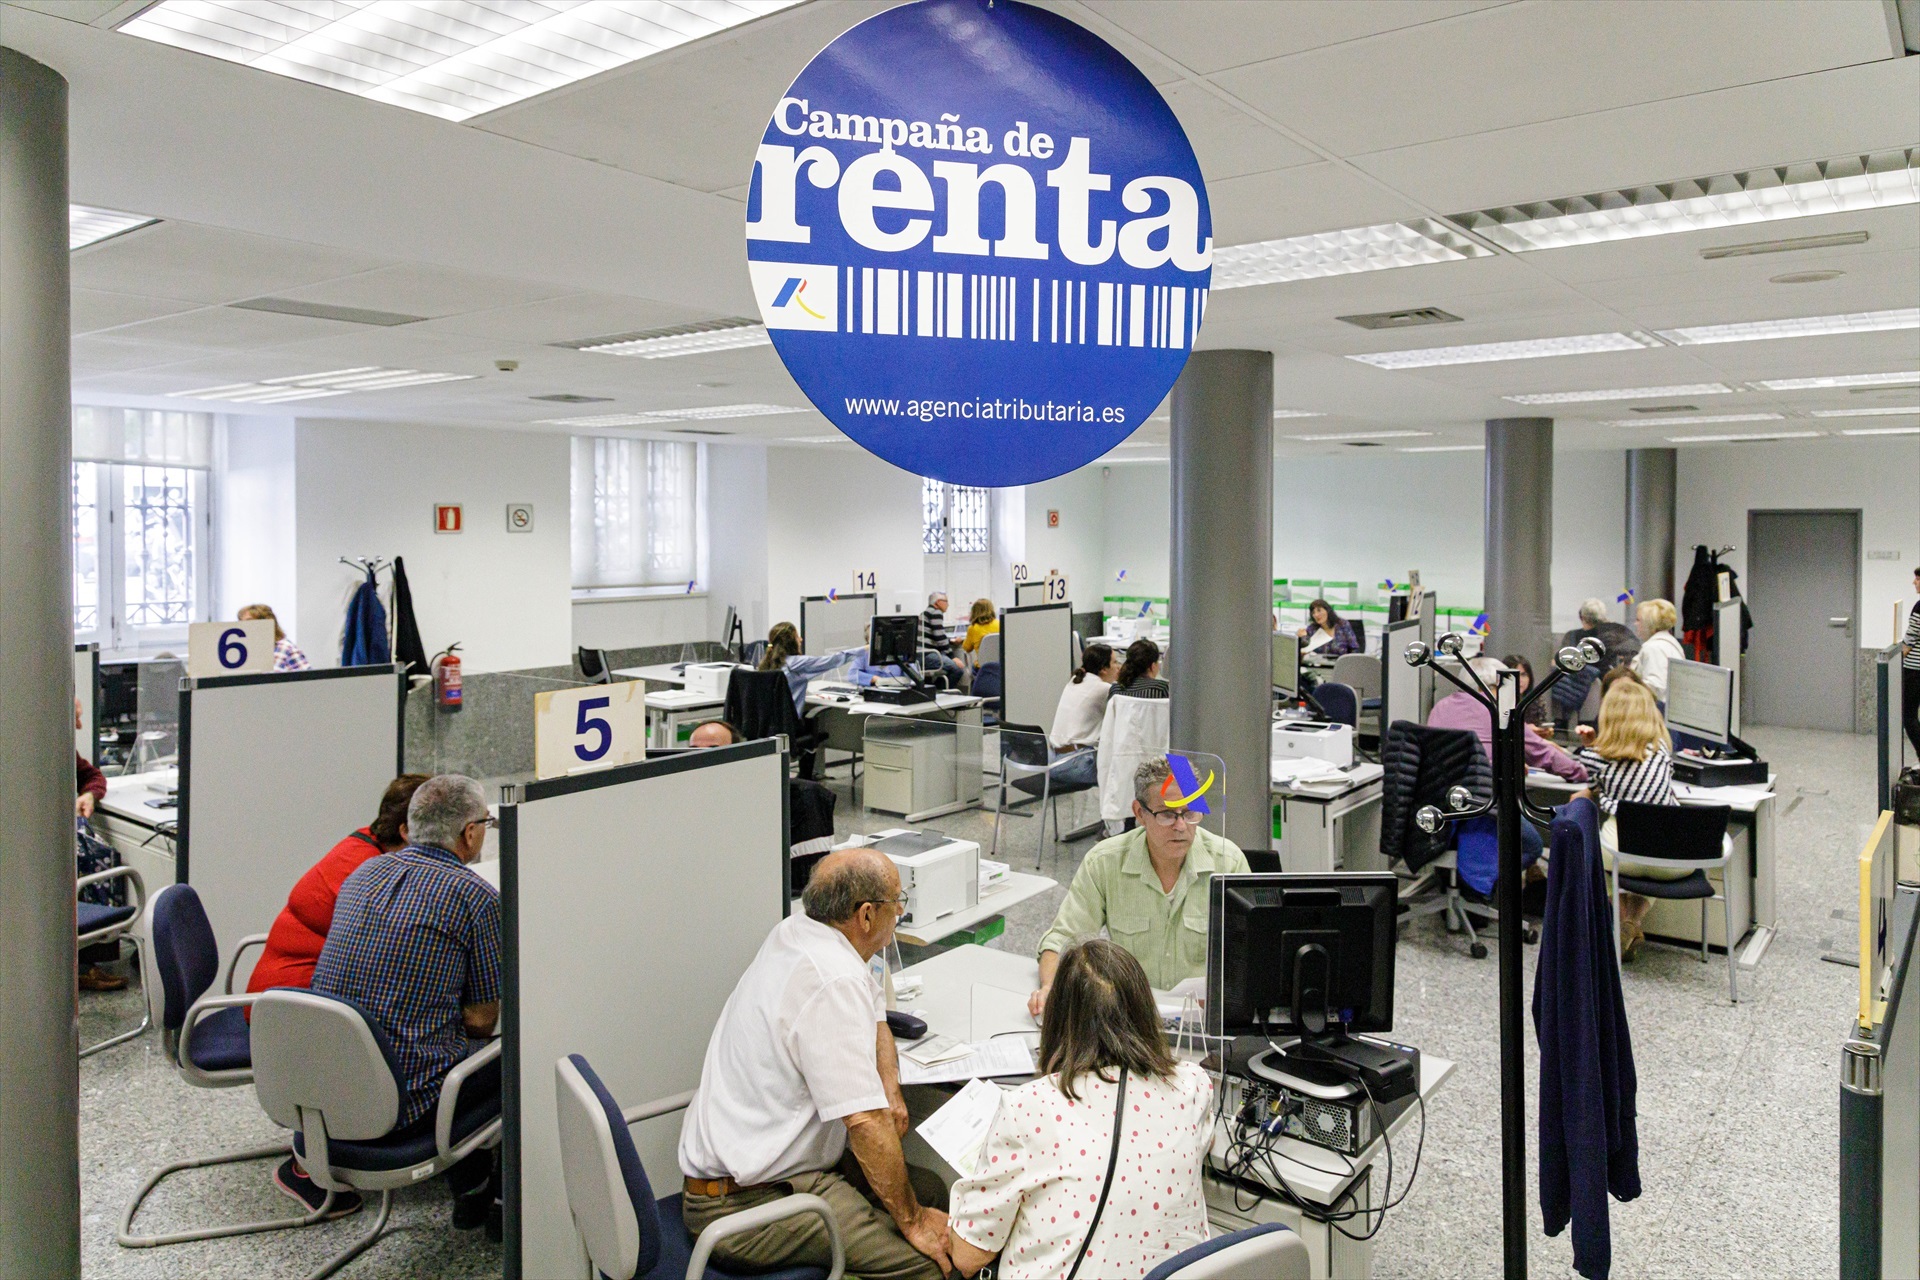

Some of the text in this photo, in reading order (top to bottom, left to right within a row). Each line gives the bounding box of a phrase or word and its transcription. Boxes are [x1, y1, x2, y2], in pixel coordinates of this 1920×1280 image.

[774, 96, 1055, 158] Campaña de
[746, 137, 1213, 272] renta
[845, 397, 1125, 423] www.agenciatributaria.es
[857, 572, 876, 590] 14
[1014, 565, 1028, 580] 20
[1048, 579, 1066, 600] 13
[218, 628, 247, 668] 6
[574, 697, 612, 761] 5
